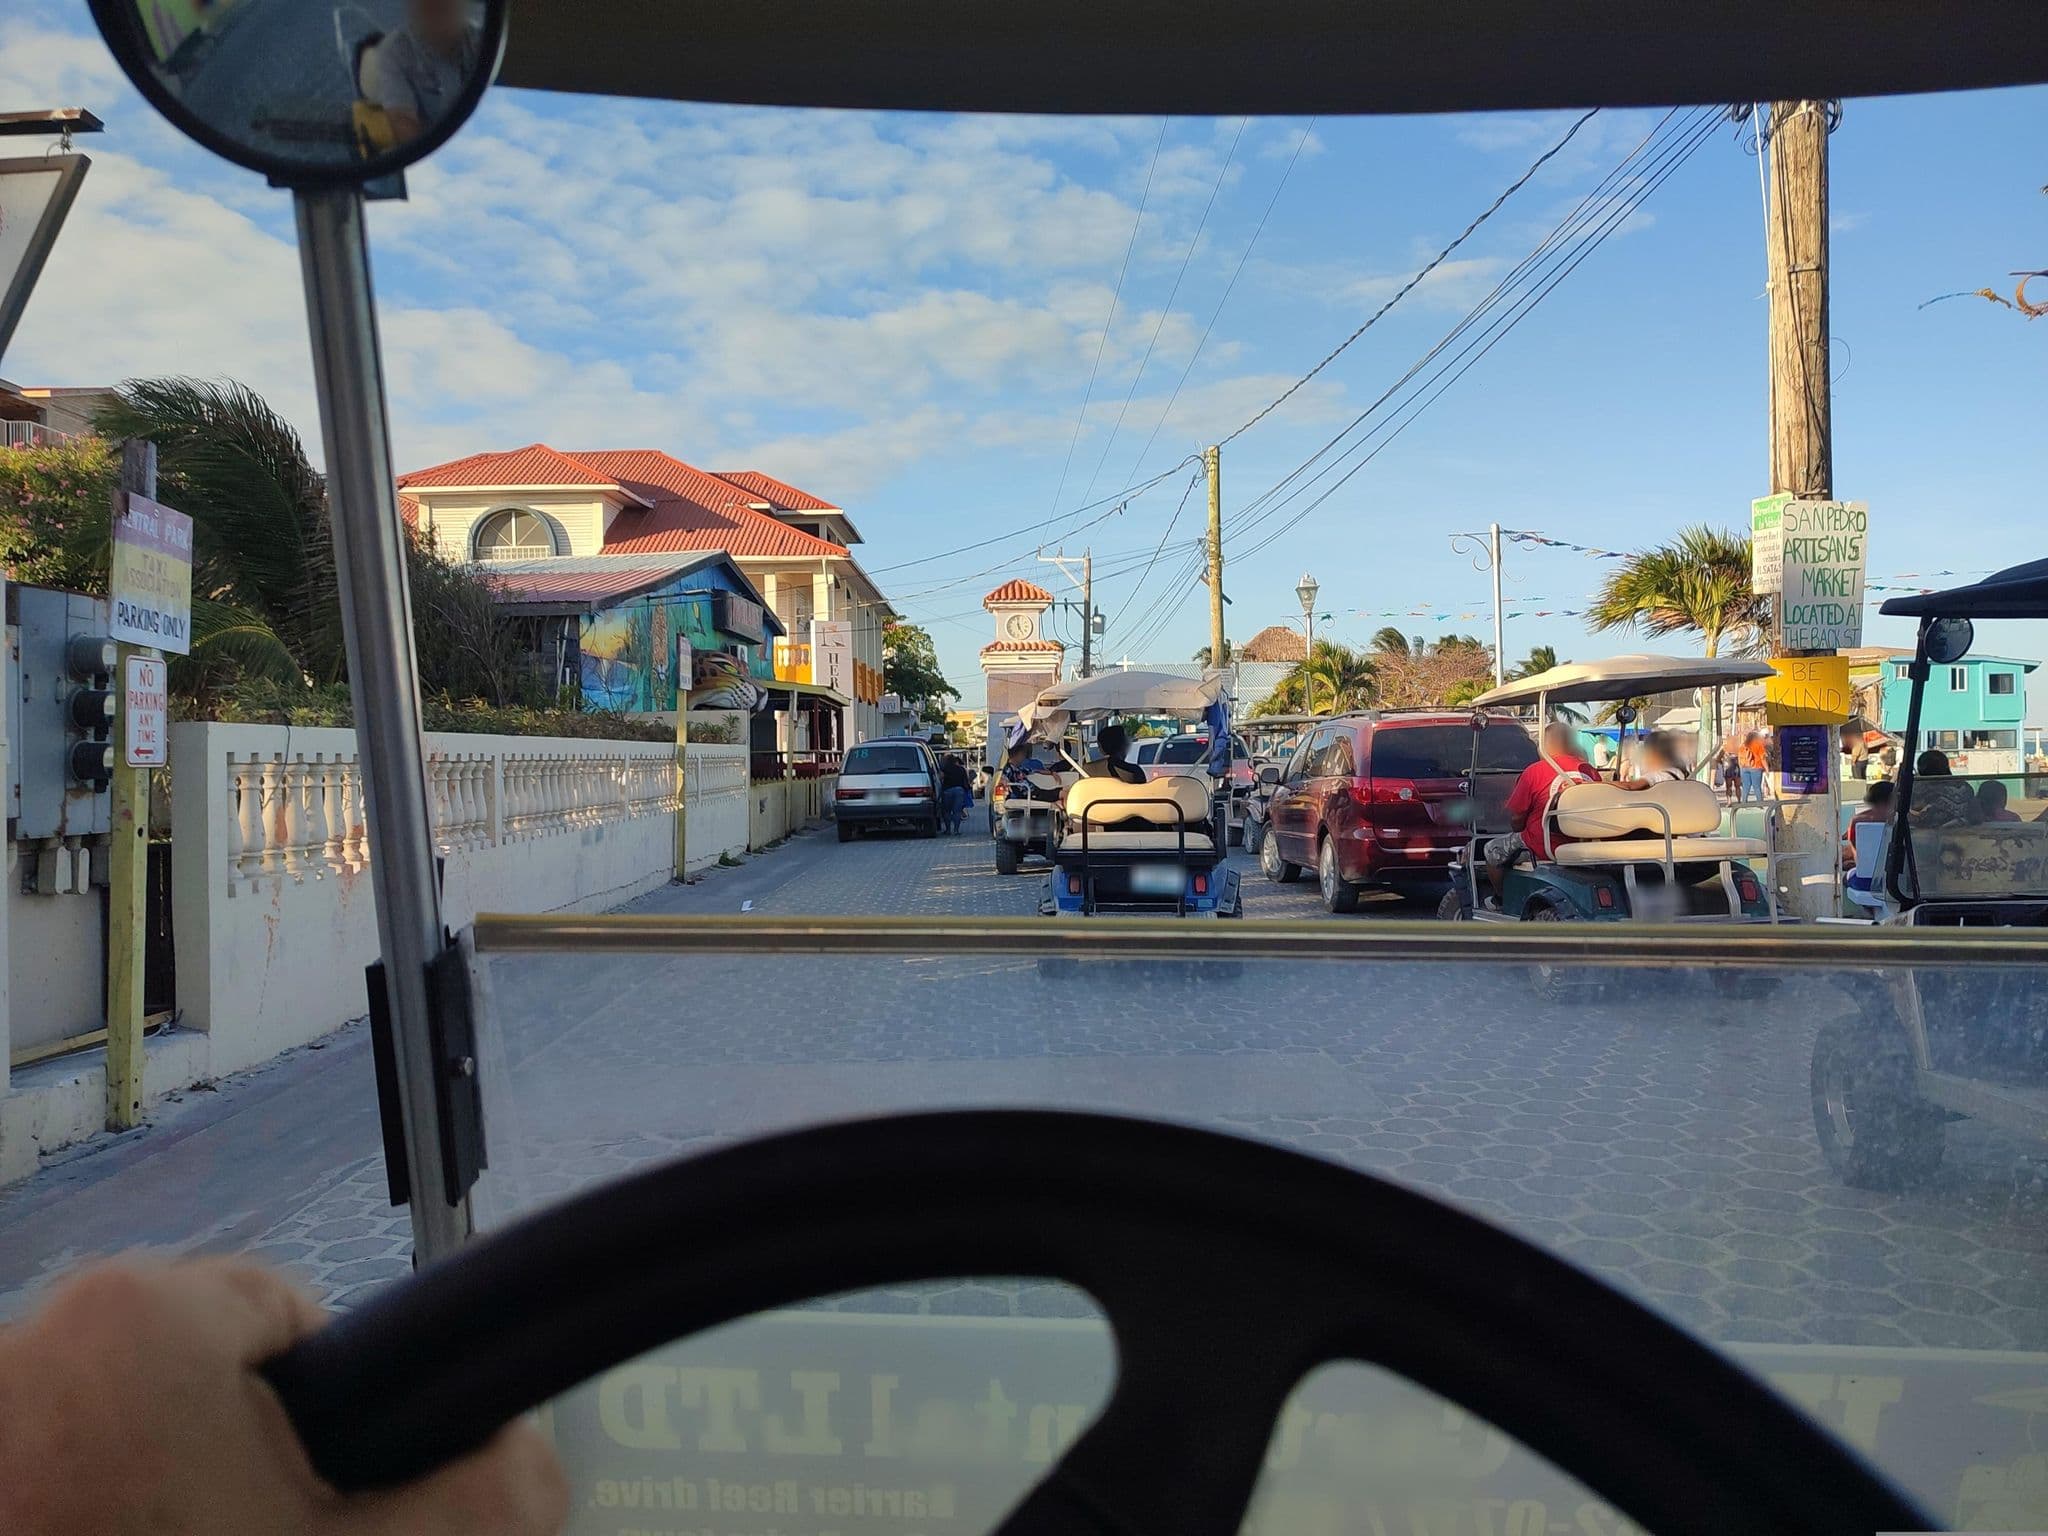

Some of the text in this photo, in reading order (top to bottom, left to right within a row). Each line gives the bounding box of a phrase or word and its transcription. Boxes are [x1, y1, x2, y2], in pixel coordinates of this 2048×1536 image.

[1783, 502, 1825, 532] SAN
[1827, 505, 1867, 532] PEDRO
[1783, 535, 1863, 564] ARTISANS
[1801, 567, 1861, 597] MARKET
[117, 601, 187, 641] PARKING ONLY
[1784, 600, 1864, 625] LOCATED AT
[1783, 627, 1860, 649] THE BACK ST
[139, 668, 154, 688] NO
[1791, 661, 1824, 682] BE
[128, 690, 165, 712] PARKING
[1773, 687, 1842, 713] KIND
[139, 713, 153, 726] ANY
[138, 729, 156, 743] TIME
